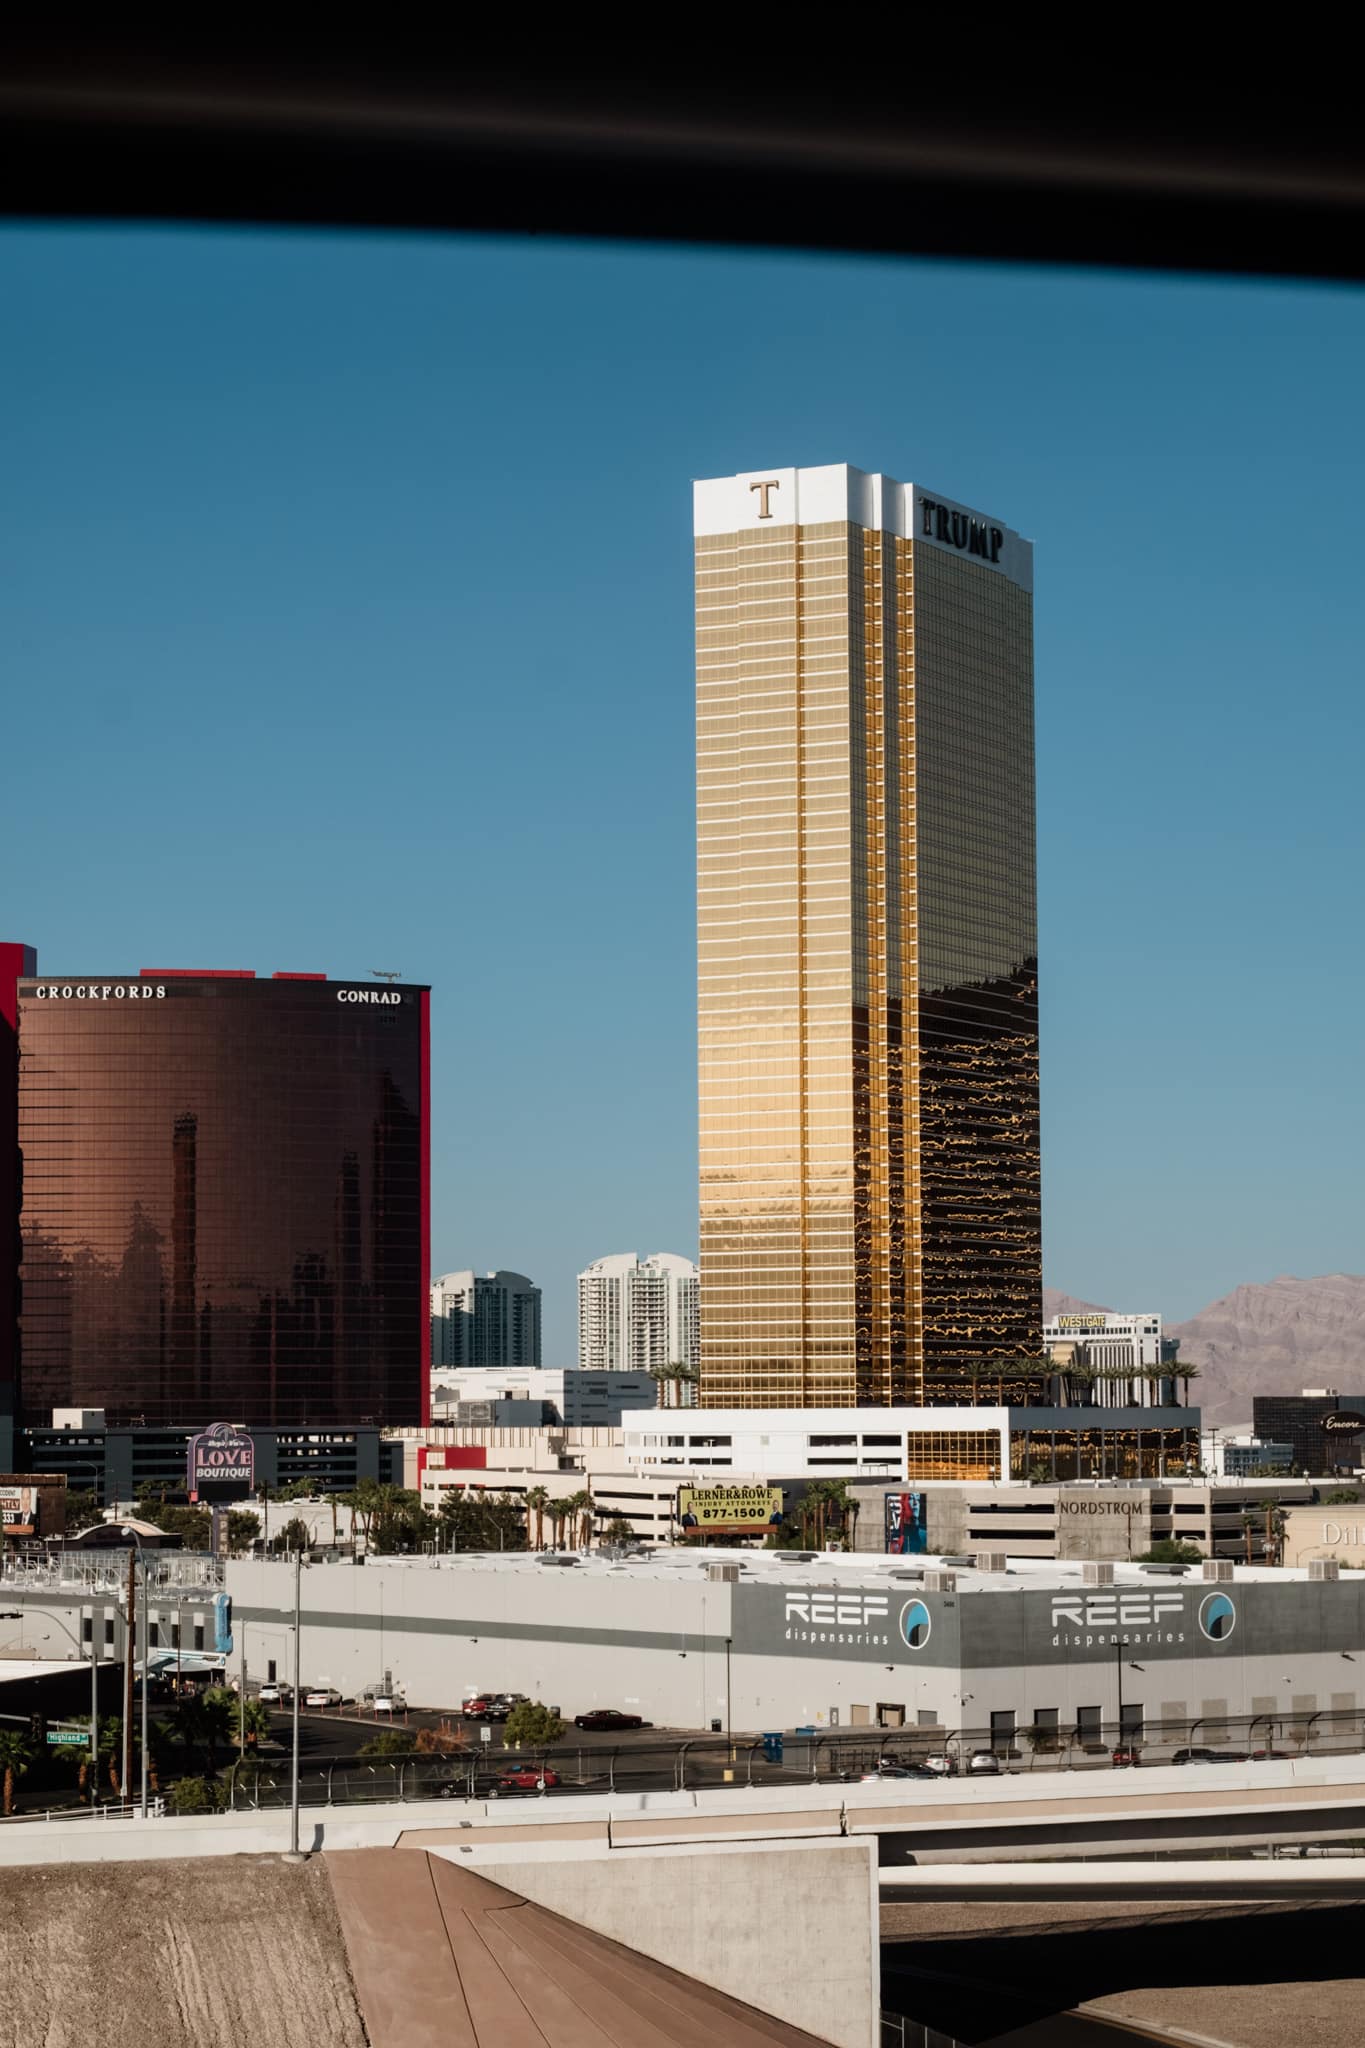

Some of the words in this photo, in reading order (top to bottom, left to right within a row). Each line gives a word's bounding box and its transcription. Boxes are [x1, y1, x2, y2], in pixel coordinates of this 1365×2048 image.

[749, 479, 780, 520] T
[917, 496, 1004, 563] TRUMP
[36, 985, 167, 1001] CROCKFORDS
[336, 989, 402, 1005] CONRAD
[1058, 1315, 1106, 1328] WESTGATE
[1325, 1416, 1362, 1430] Encore
[196, 1448, 252, 1466] LOVE
[196, 1467, 251, 1479] BOUTIQUE
[695, 1500, 723, 1508] INJURY
[725, 1499, 771, 1507] ATTORNEYS
[1060, 1502, 1143, 1515] NORDSTROM
[703, 1508, 766, 1519] 877-1500
[785, 1592, 889, 1626] REEF
[1051, 1592, 1185, 1628] REEF
[785, 1627, 889, 1646] dispensaries
[1051, 1630, 1186, 1648] dispensaries
[50, 1733, 81, 1743] Highland
